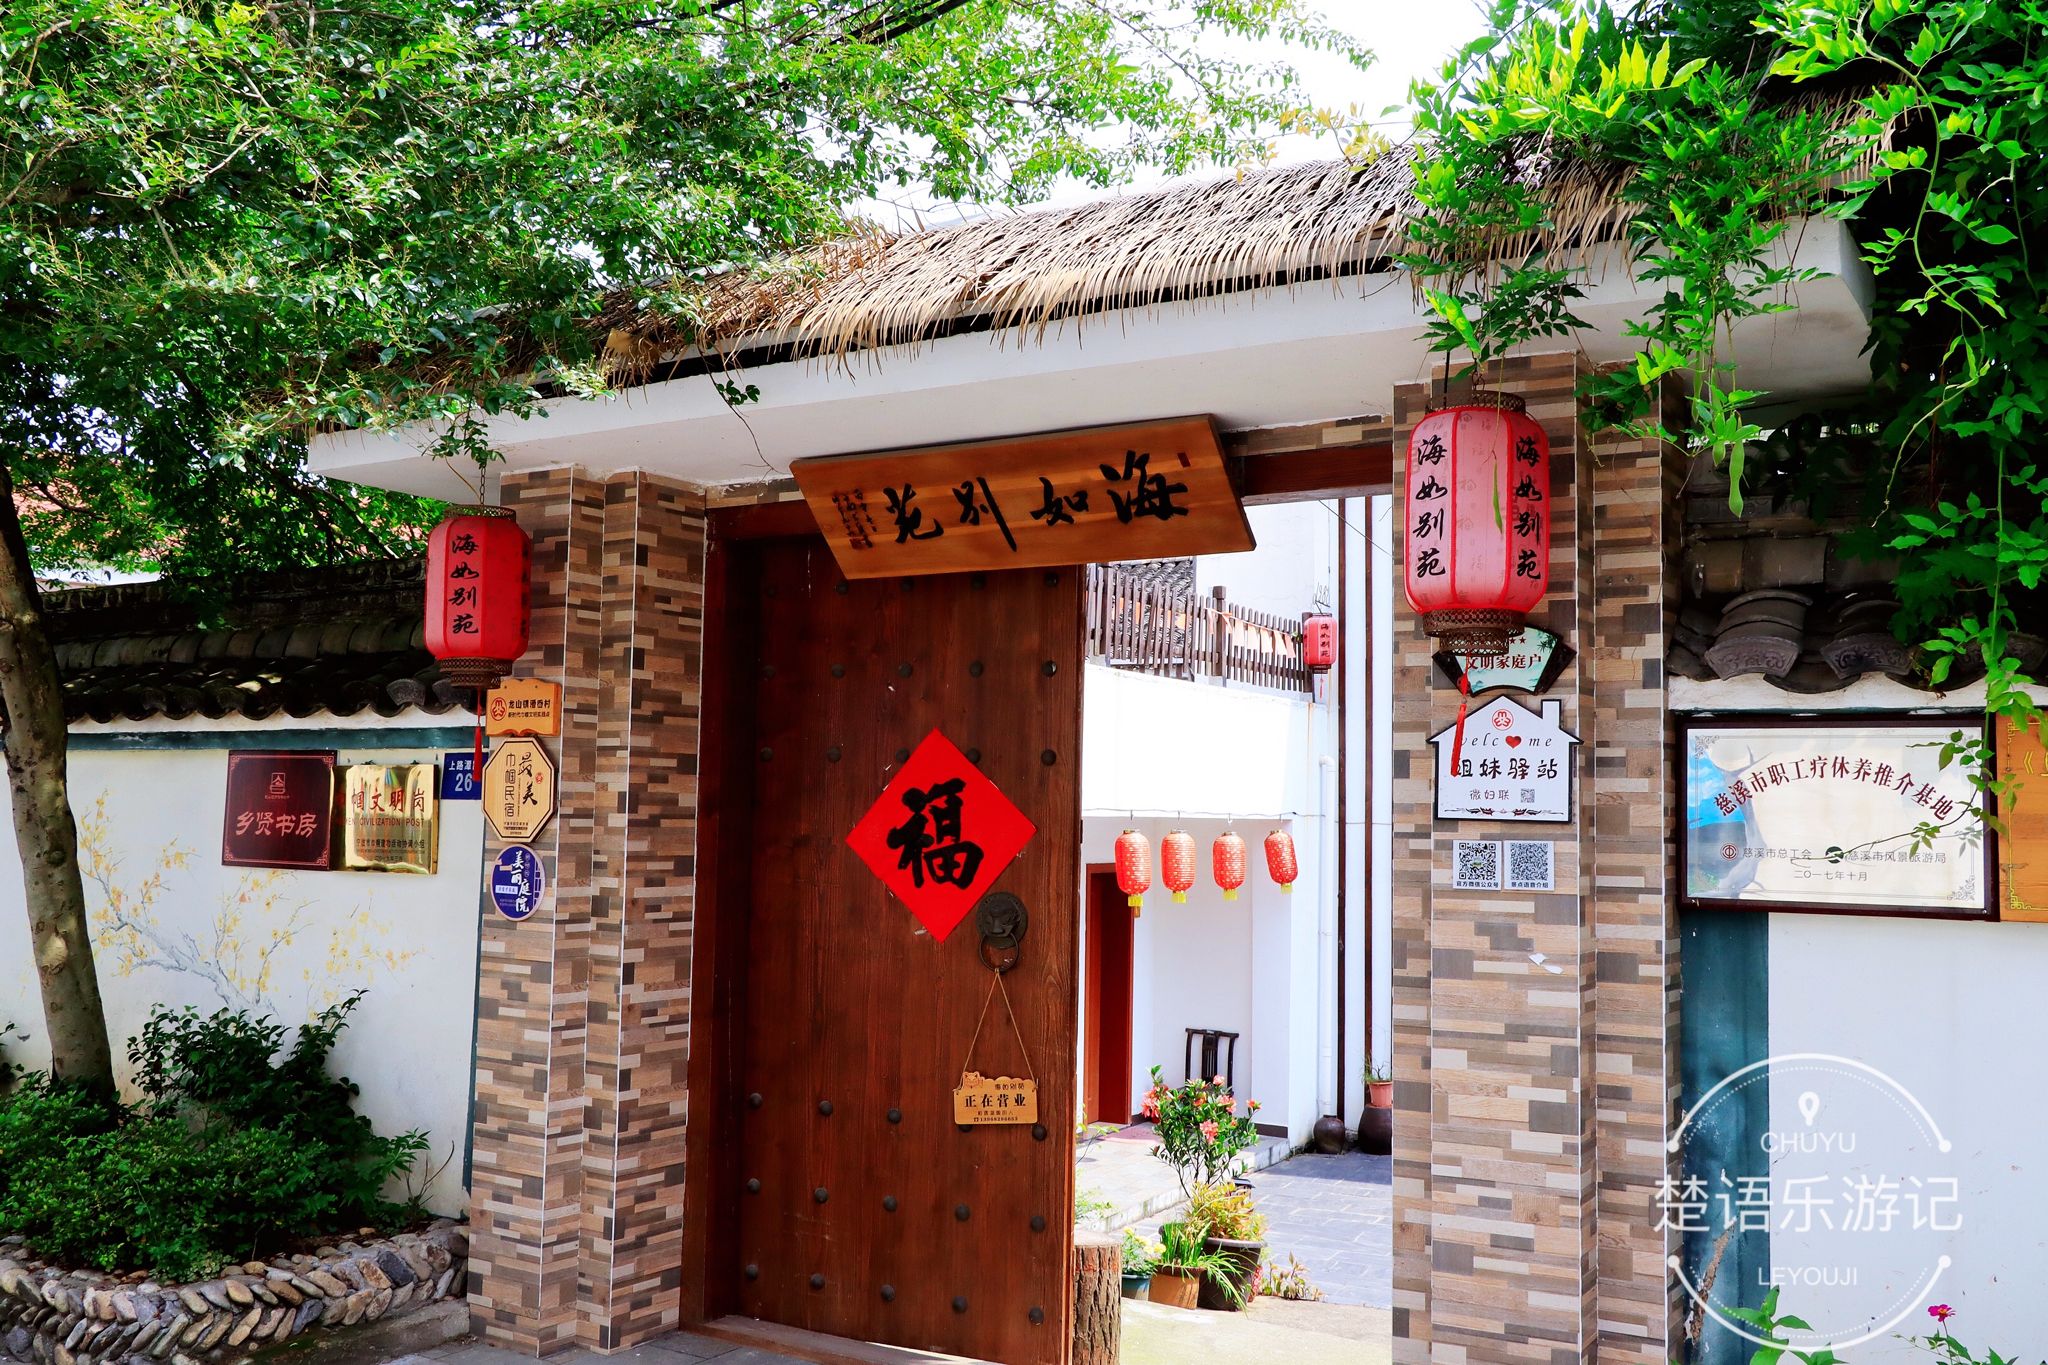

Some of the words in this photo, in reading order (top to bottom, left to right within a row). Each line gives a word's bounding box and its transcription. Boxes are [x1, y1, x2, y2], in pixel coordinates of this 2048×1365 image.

[1412, 434, 1449, 579] 海如别苑
[1513, 435, 1543, 581] 海如别苑
[448, 533, 480, 636] 海如别苑
[1467, 653, 1542, 670] 文明家庭户
[1457, 757, 1558, 780] 姐妹驿站
[454, 772, 473, 792] 26
[504, 752, 516, 818] 巾帼民宿
[1712, 754, 1955, 822] 慈溪市职工疗休养推介基地
[235, 810, 318, 838] 乡贤书房
[360, 817, 401, 827] CIVILIZATION
[405, 817, 425, 827] POST
[886, 777, 985, 891] 福
[1742, 847, 1813, 861] 慈溪市总工会
[1846, 850, 1947, 864] 慈溪市风景旅游局
[510, 850, 532, 913] 美丽庭院
[1456, 880, 1499, 888] 官方微信公众号
[964, 1093, 1027, 1108] 正在营业
